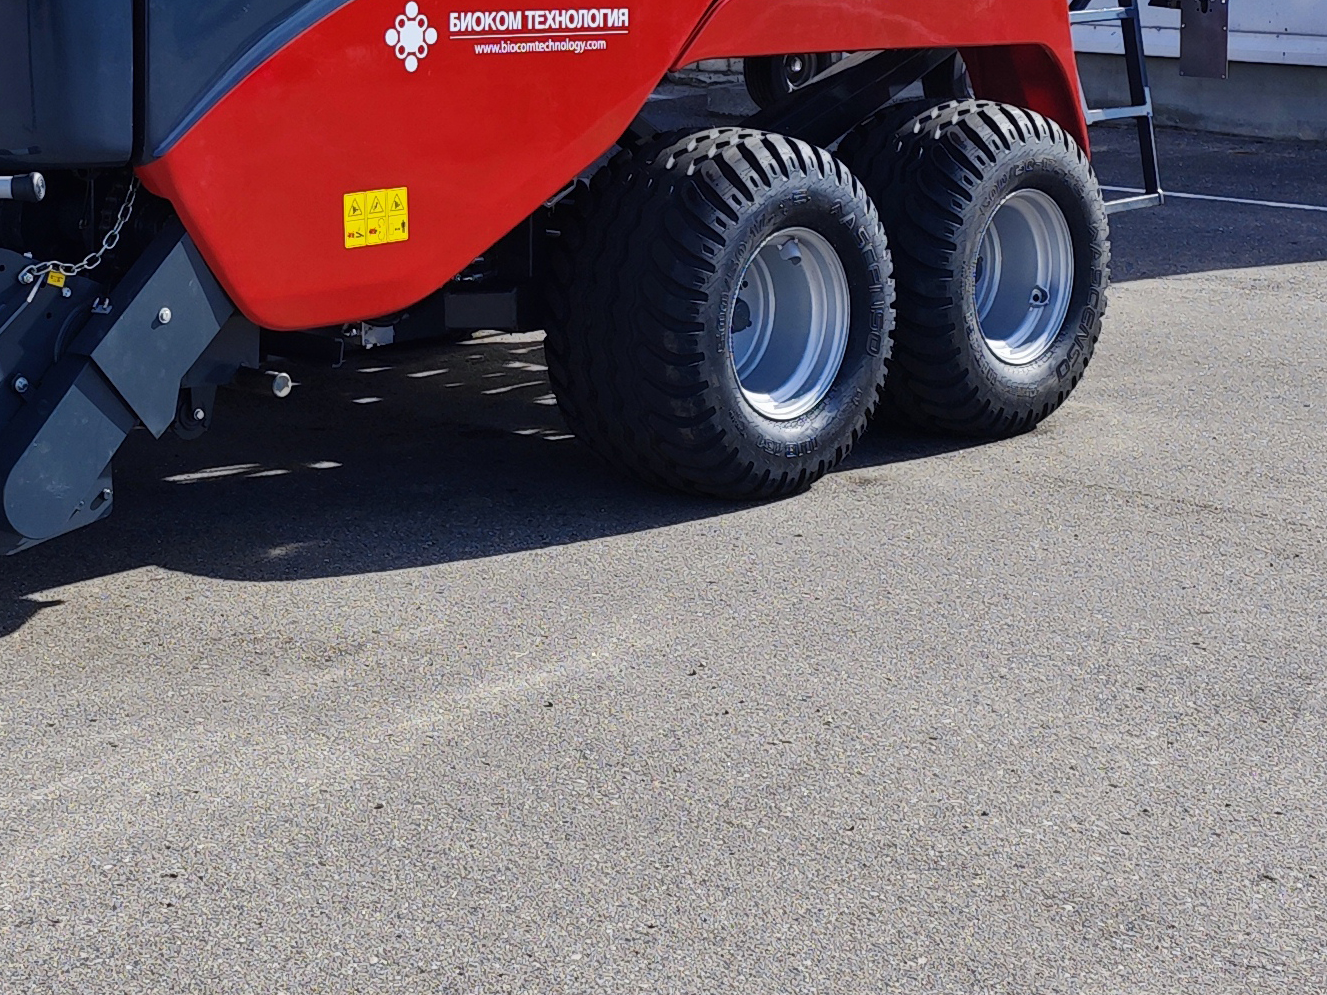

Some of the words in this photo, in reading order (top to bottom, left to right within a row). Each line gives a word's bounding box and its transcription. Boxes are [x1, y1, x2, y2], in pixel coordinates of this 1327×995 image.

[449, 10, 522, 32] БИОКОМ
[525, 8, 629, 30] ТЕХНОЛОГИЯ
[474, 39, 606, 54] www.biocomtechnology.com
[1055, 223, 1103, 383] ASCENSO
